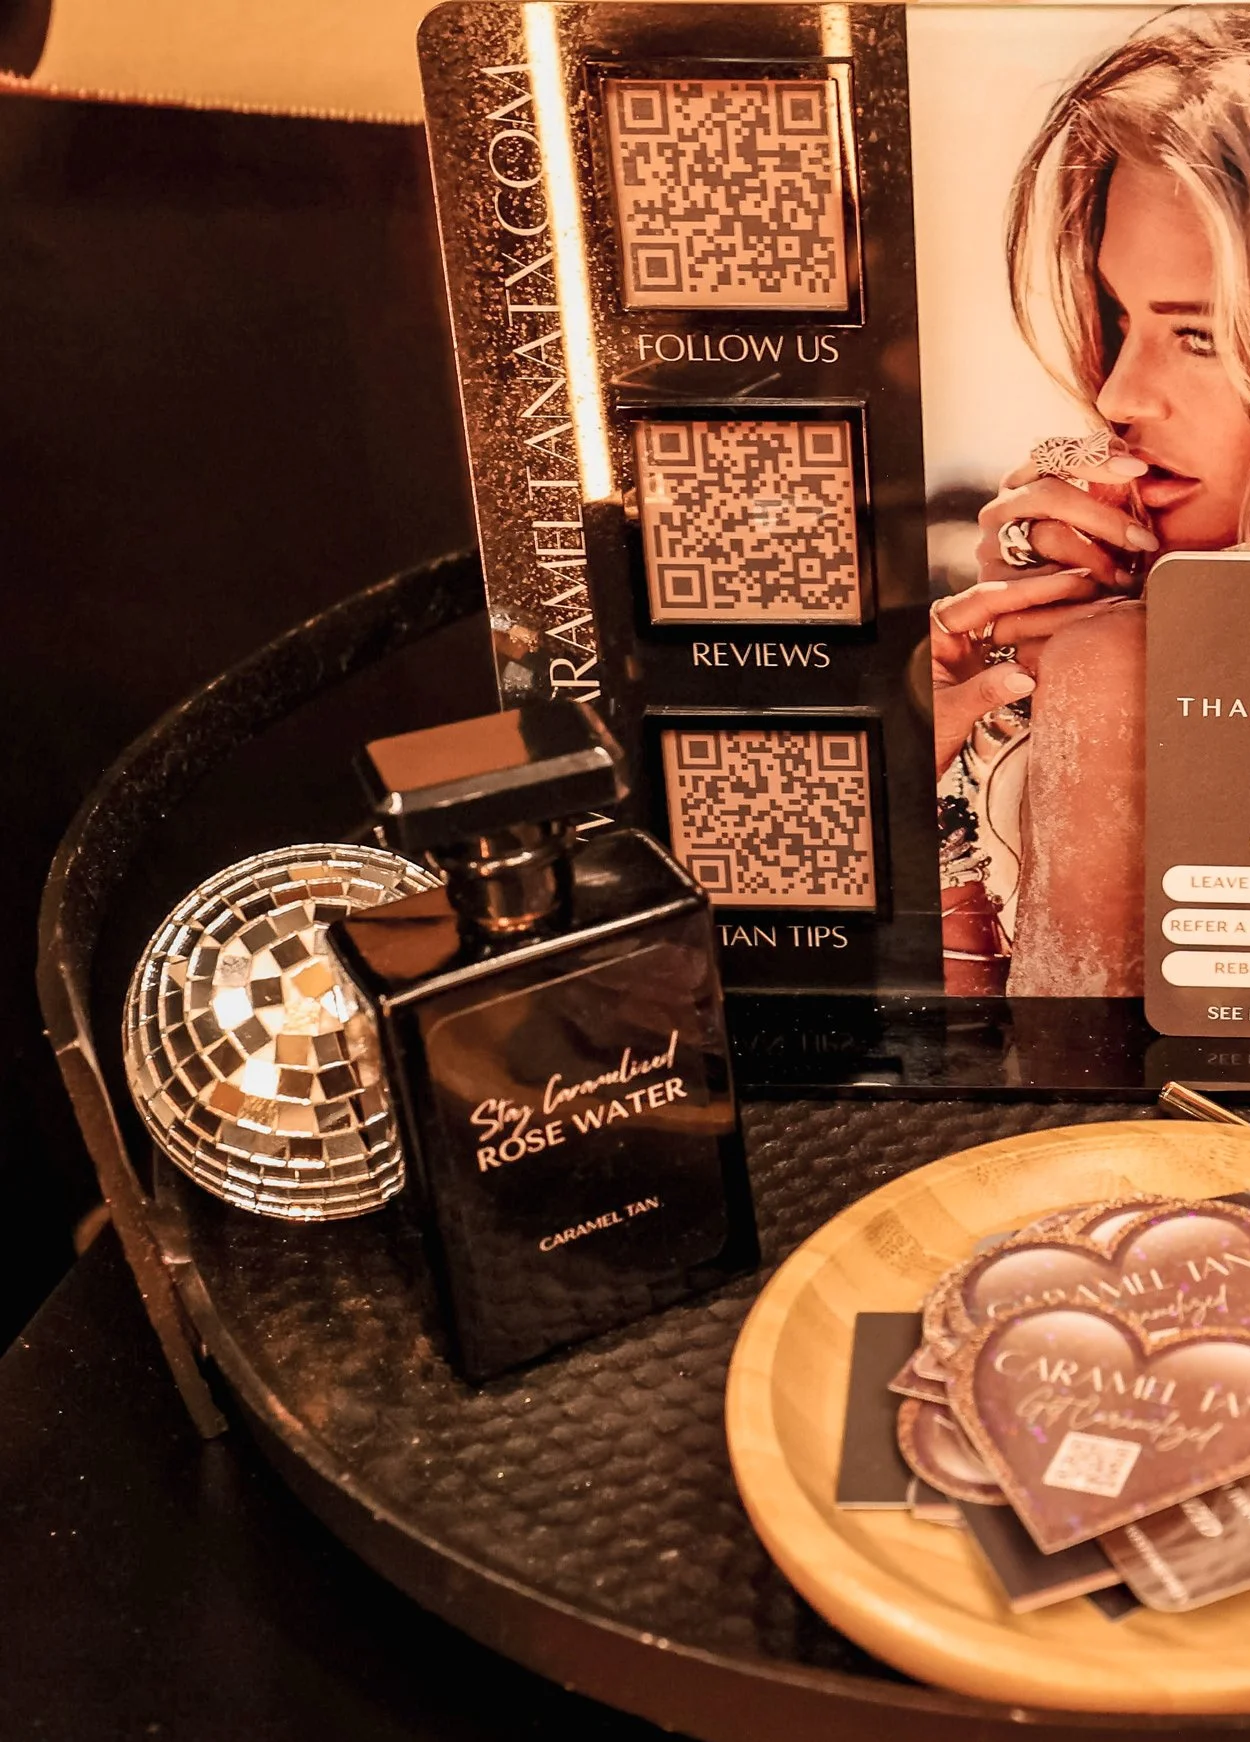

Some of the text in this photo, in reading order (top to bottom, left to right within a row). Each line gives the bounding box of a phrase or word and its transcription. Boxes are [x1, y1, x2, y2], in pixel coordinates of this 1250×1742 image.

[638, 334, 839, 363] FOLLOW US
[692, 642, 831, 669] REVIEWS
[1190, 876, 1249, 890] LEAVE
[716, 924, 849, 949] TAN TIPS
[1170, 919, 1228, 933] REFER
[1233, 920, 1246, 934] A
[1207, 1006, 1243, 1021] SEE
[469, 1097, 535, 1142] Stay
[476, 1076, 688, 1173] ROSE WATER
[538, 1195, 661, 1252] CARAMEL TAN
[994, 1350, 1177, 1405] CARAMEL
